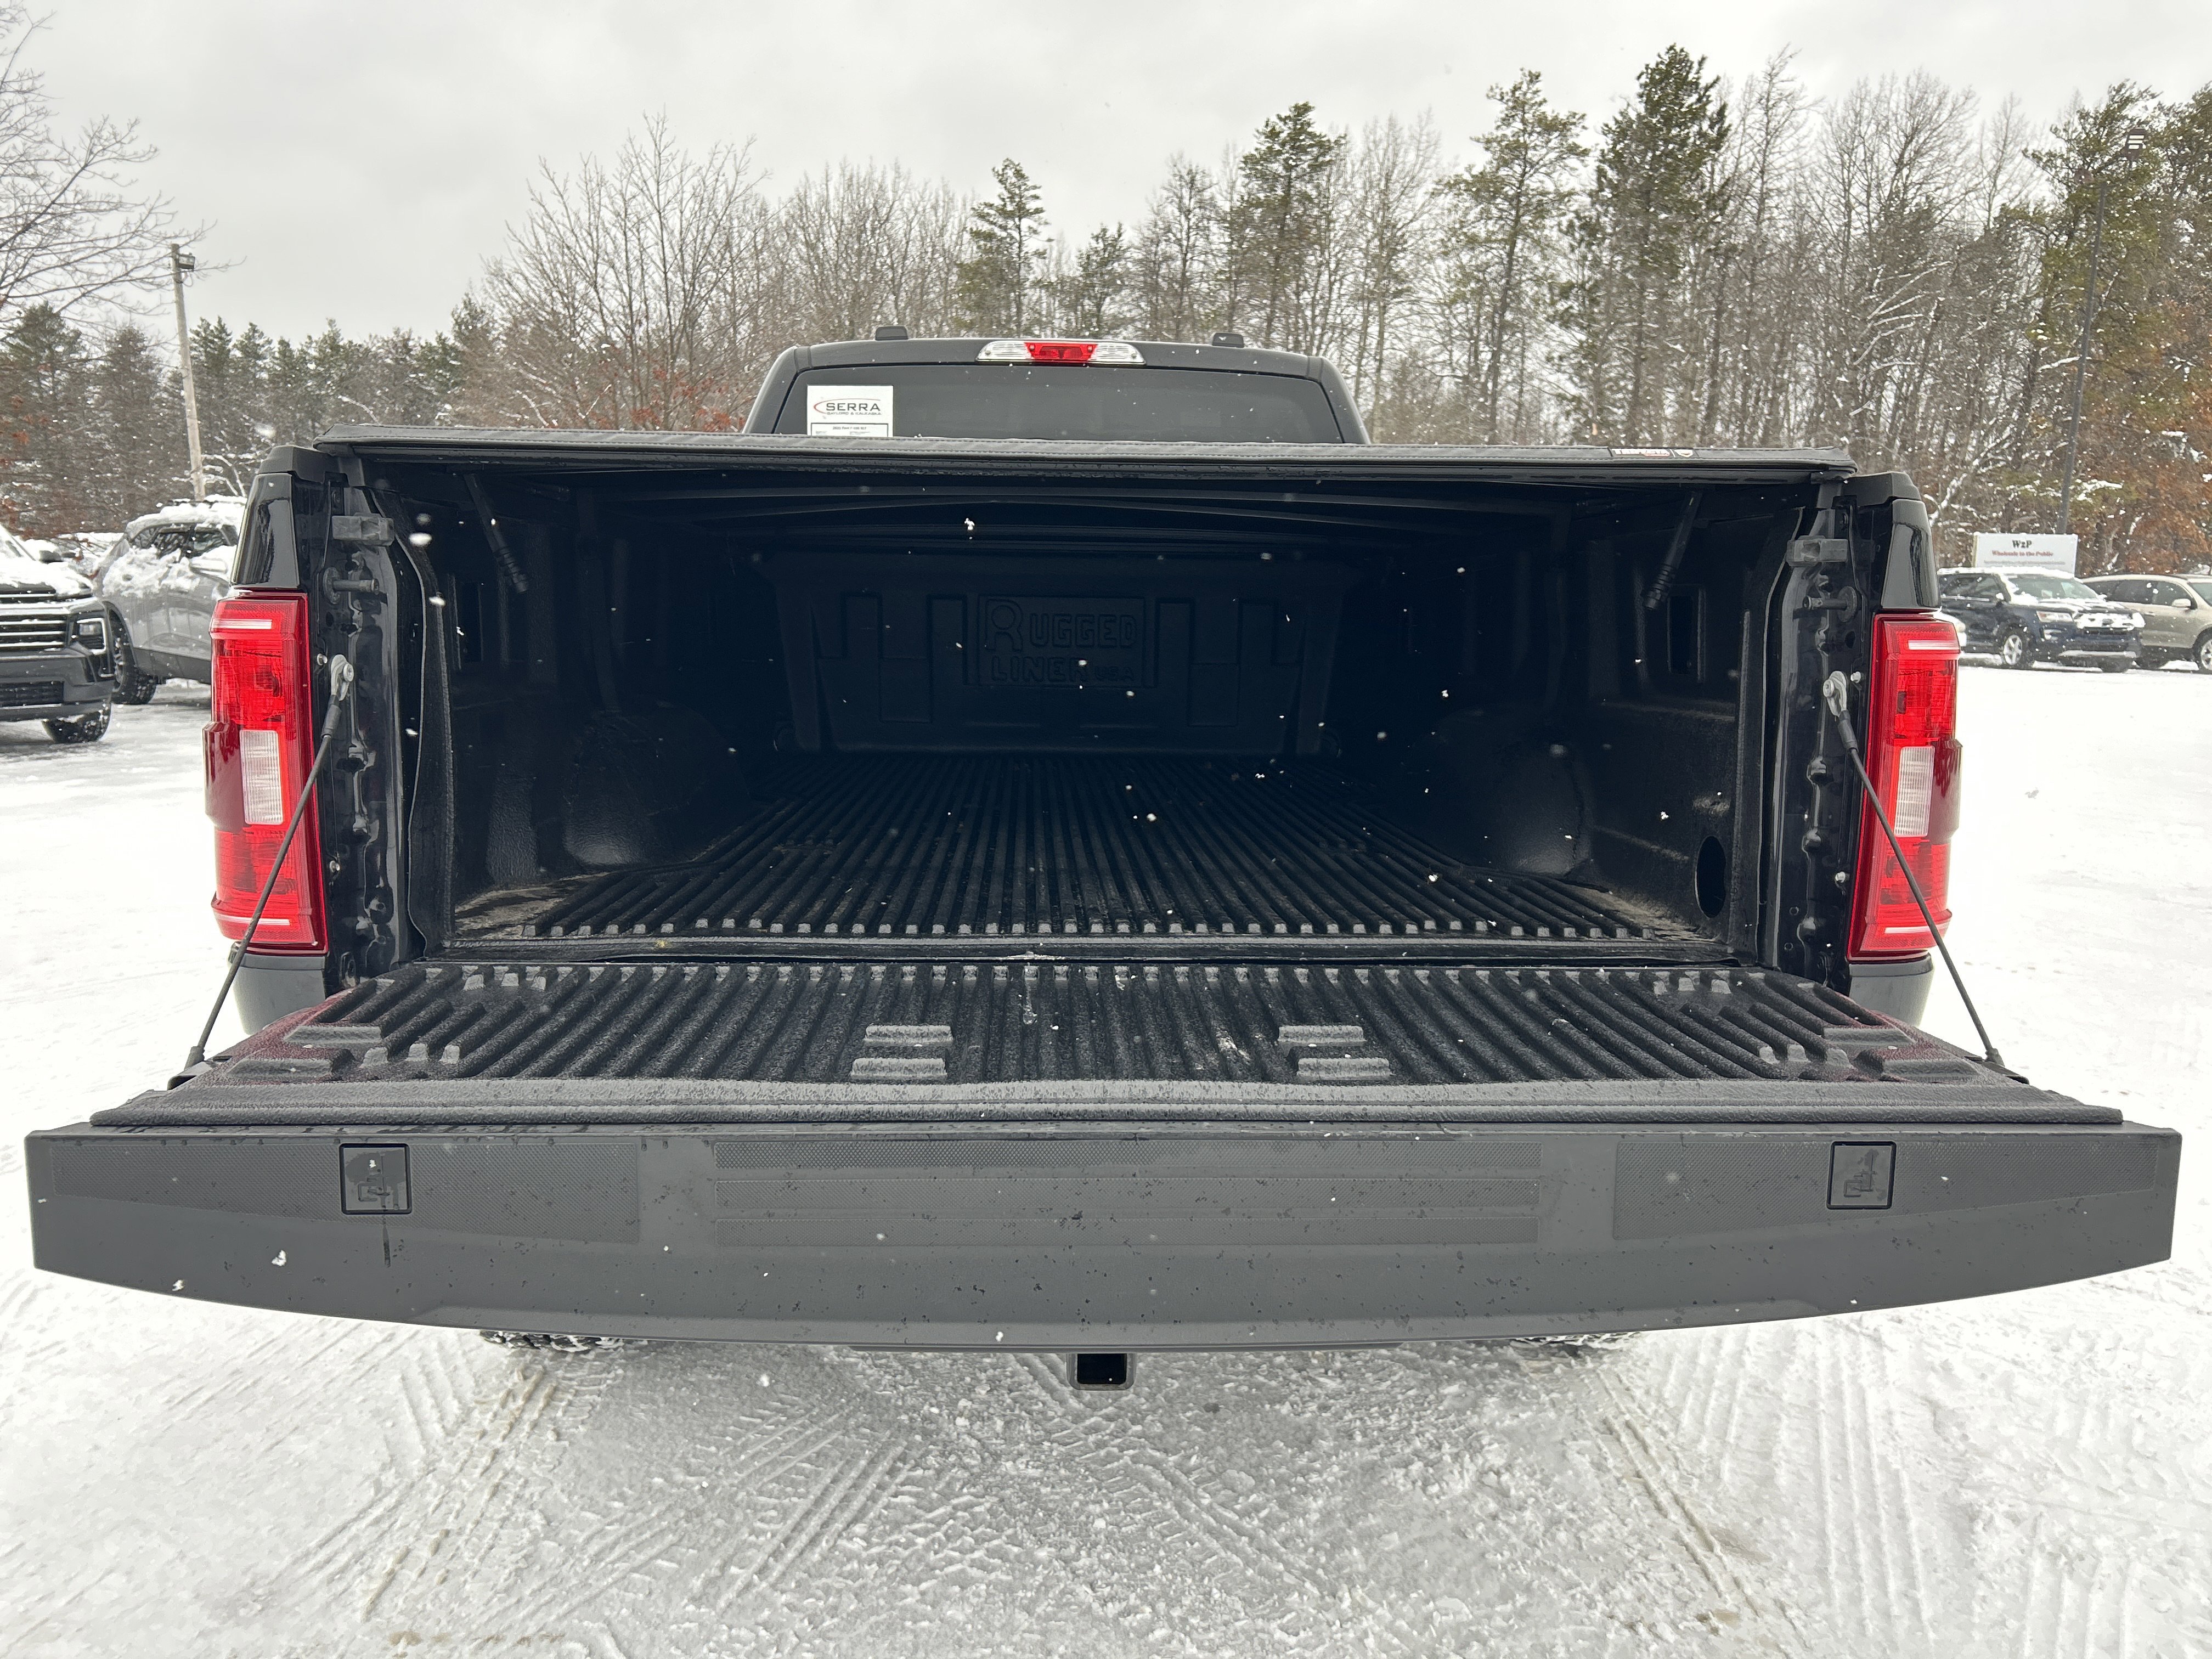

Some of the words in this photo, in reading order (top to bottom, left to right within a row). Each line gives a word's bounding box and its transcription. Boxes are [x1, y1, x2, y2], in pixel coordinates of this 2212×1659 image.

[826, 403, 881, 411] SERRA
[2011, 539, 2033, 548] W2P
[984, 598, 1138, 652] RUGGED
